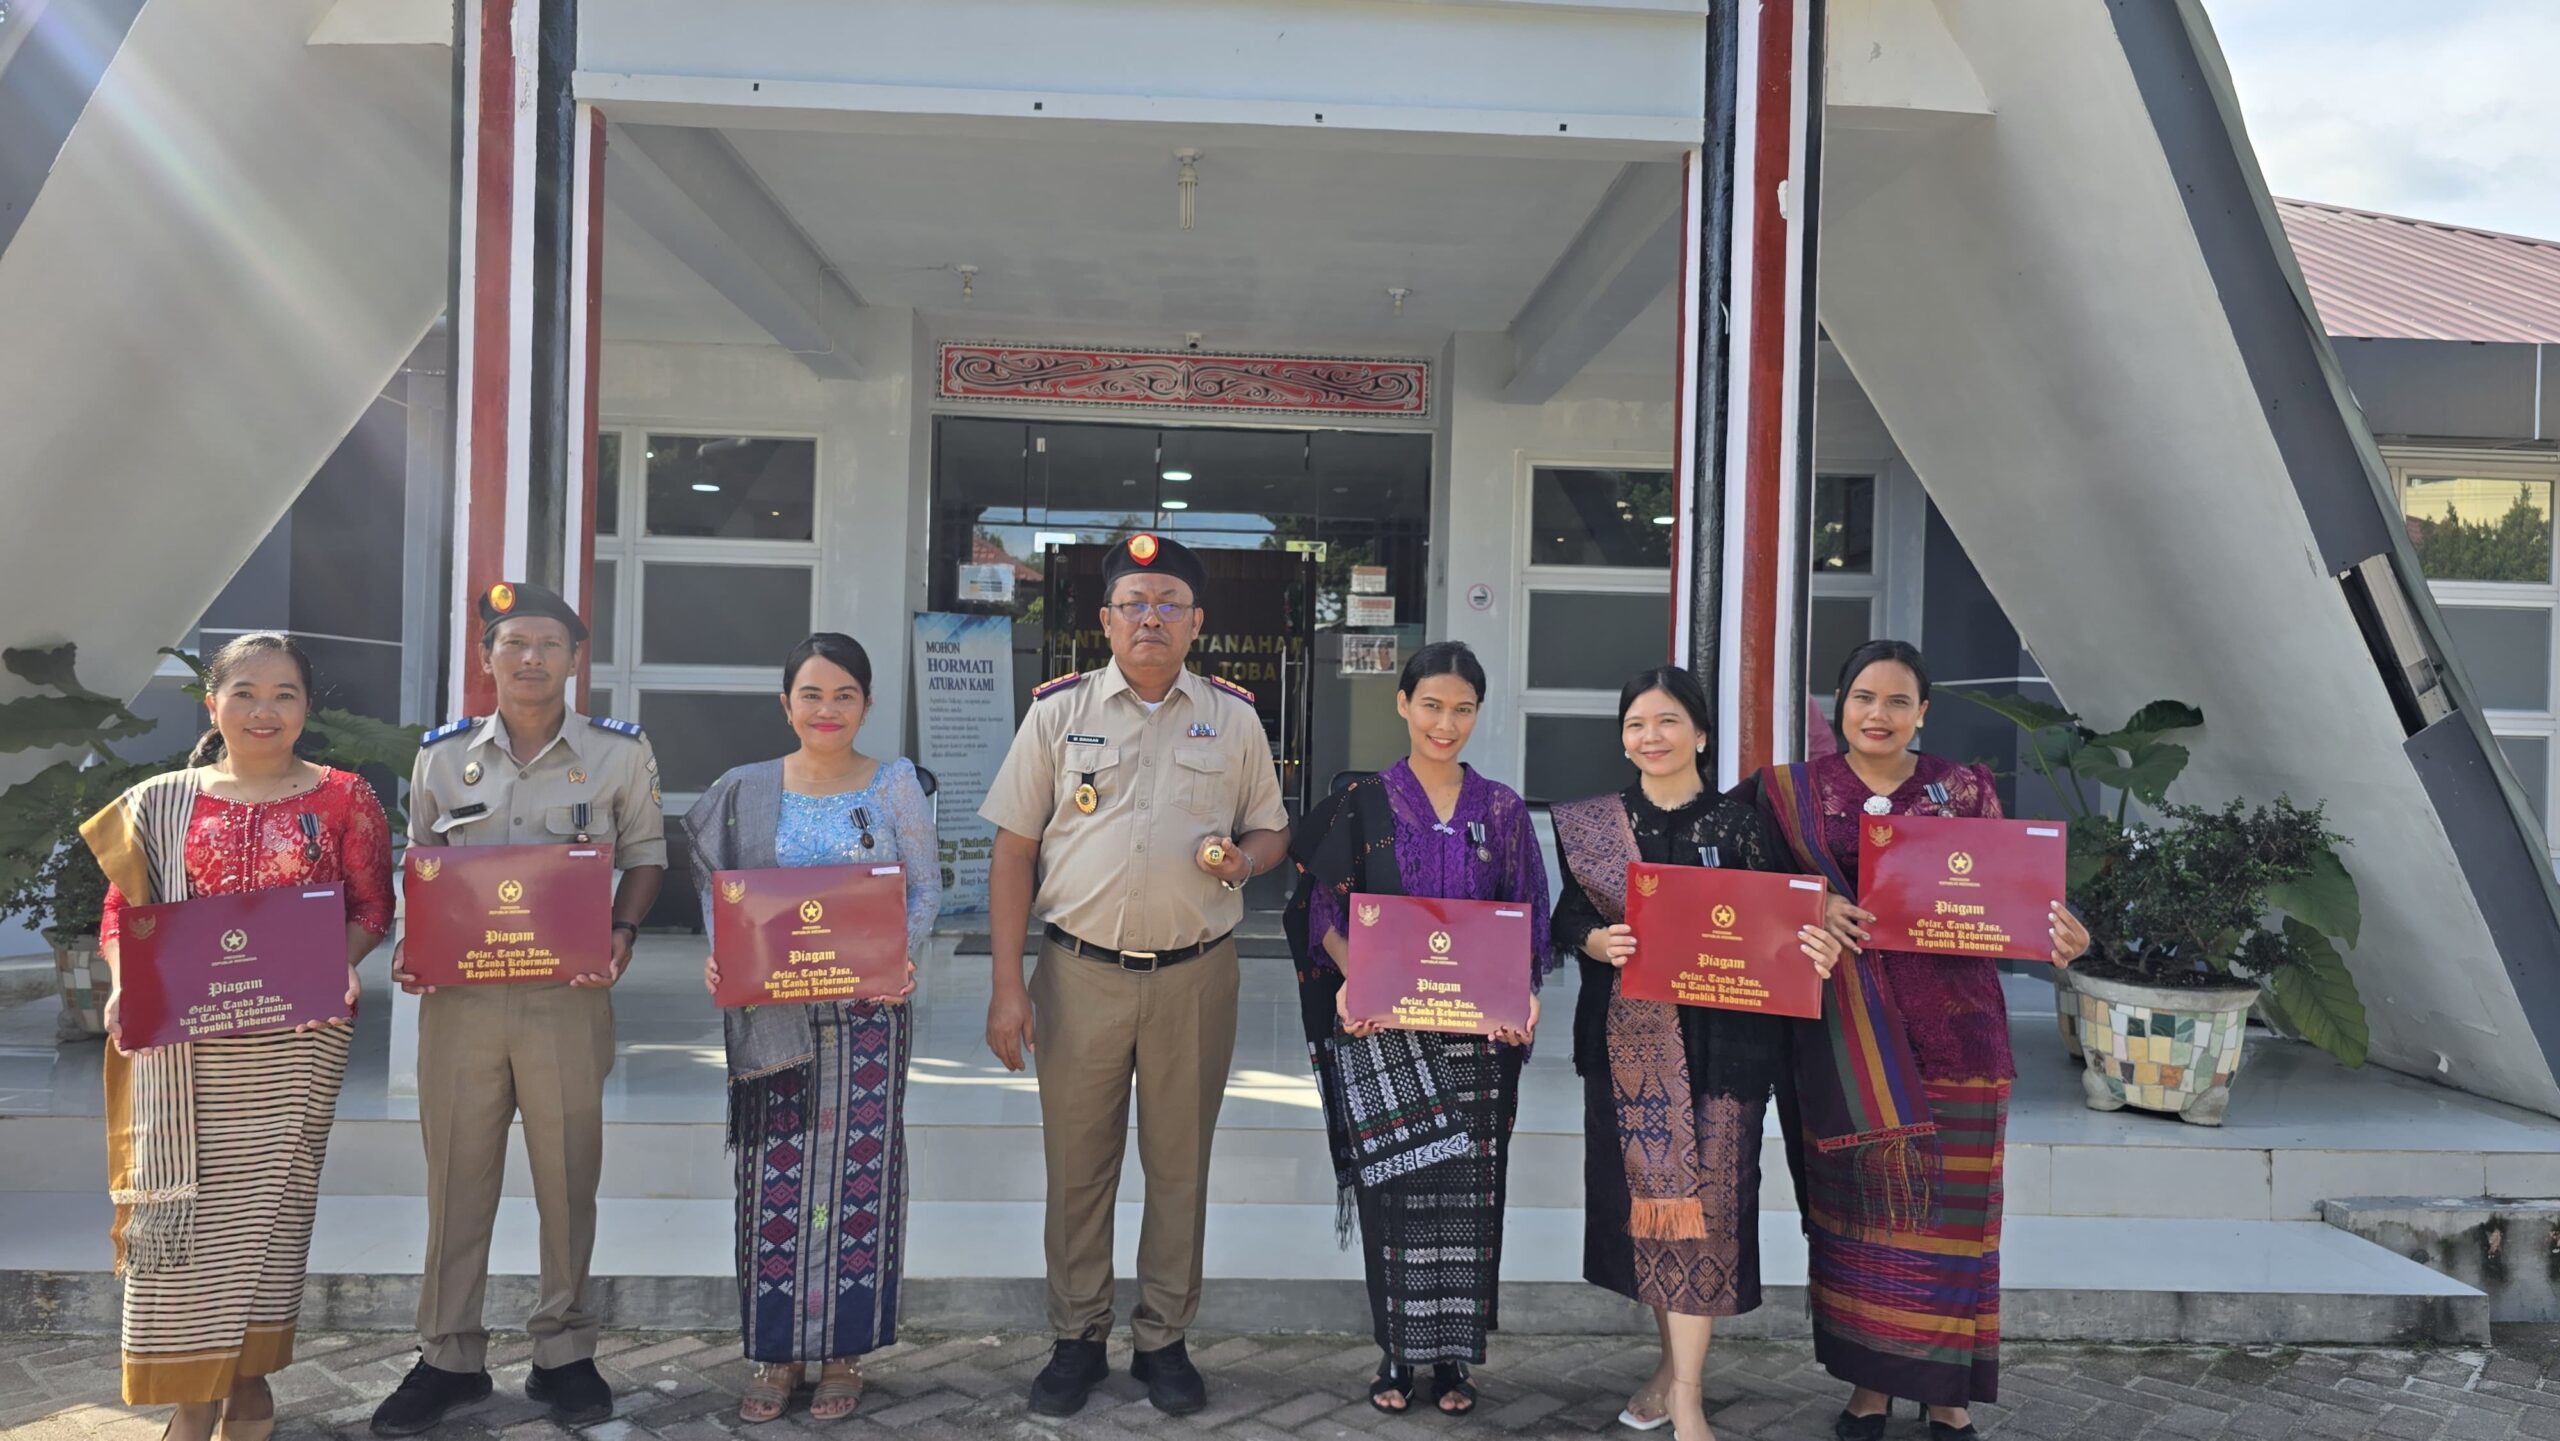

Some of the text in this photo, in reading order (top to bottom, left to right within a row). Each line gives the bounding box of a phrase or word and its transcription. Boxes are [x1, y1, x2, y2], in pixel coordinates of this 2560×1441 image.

[925, 641, 961, 655] MOHON
[927, 657, 994, 674] HORMATI
[1219, 661, 1277, 681] TOBA
[928, 676, 994, 692] ATURAN KAMI
[1935, 900, 1985, 915] Piagam
[1946, 921, 1975, 931] Tanda
[484, 930, 535, 944] Piagam
[1908, 928, 2011, 943] dan Tanda Kehormatan
[1916, 938, 2004, 952] Republik Indonesia
[496, 949, 526, 958] Tanda
[788, 950, 836, 964] Piagam
[458, 956, 560, 970] dan Tanda Kehormatan
[1698, 953, 1746, 970] Piagam
[466, 967, 553, 979] Republik Indonesia
[801, 969, 828, 977] Tanda
[1707, 974, 1735, 984] Tanda
[208, 978, 263, 998] Piagam
[764, 976, 860, 989] dan Tanda Kehormatan
[1416, 978, 1461, 994] Piagam
[1671, 980, 1770, 997] dan Tanda Kehormatan
[772, 986, 854, 1000] Republik Indonesia
[1678, 990, 1762, 1006] Republik Indonesia
[222, 998, 254, 1010] Tanda
[1427, 998, 1454, 1008] Tanda
[180, 1002, 292, 1026] dan Tanda Kehormatan
[1392, 1006, 1484, 1019] dan Tanda Kehormatan
[188, 1014, 286, 1036] Republik Indonesia
[1399, 1015, 1477, 1028] Republik Indonesia
